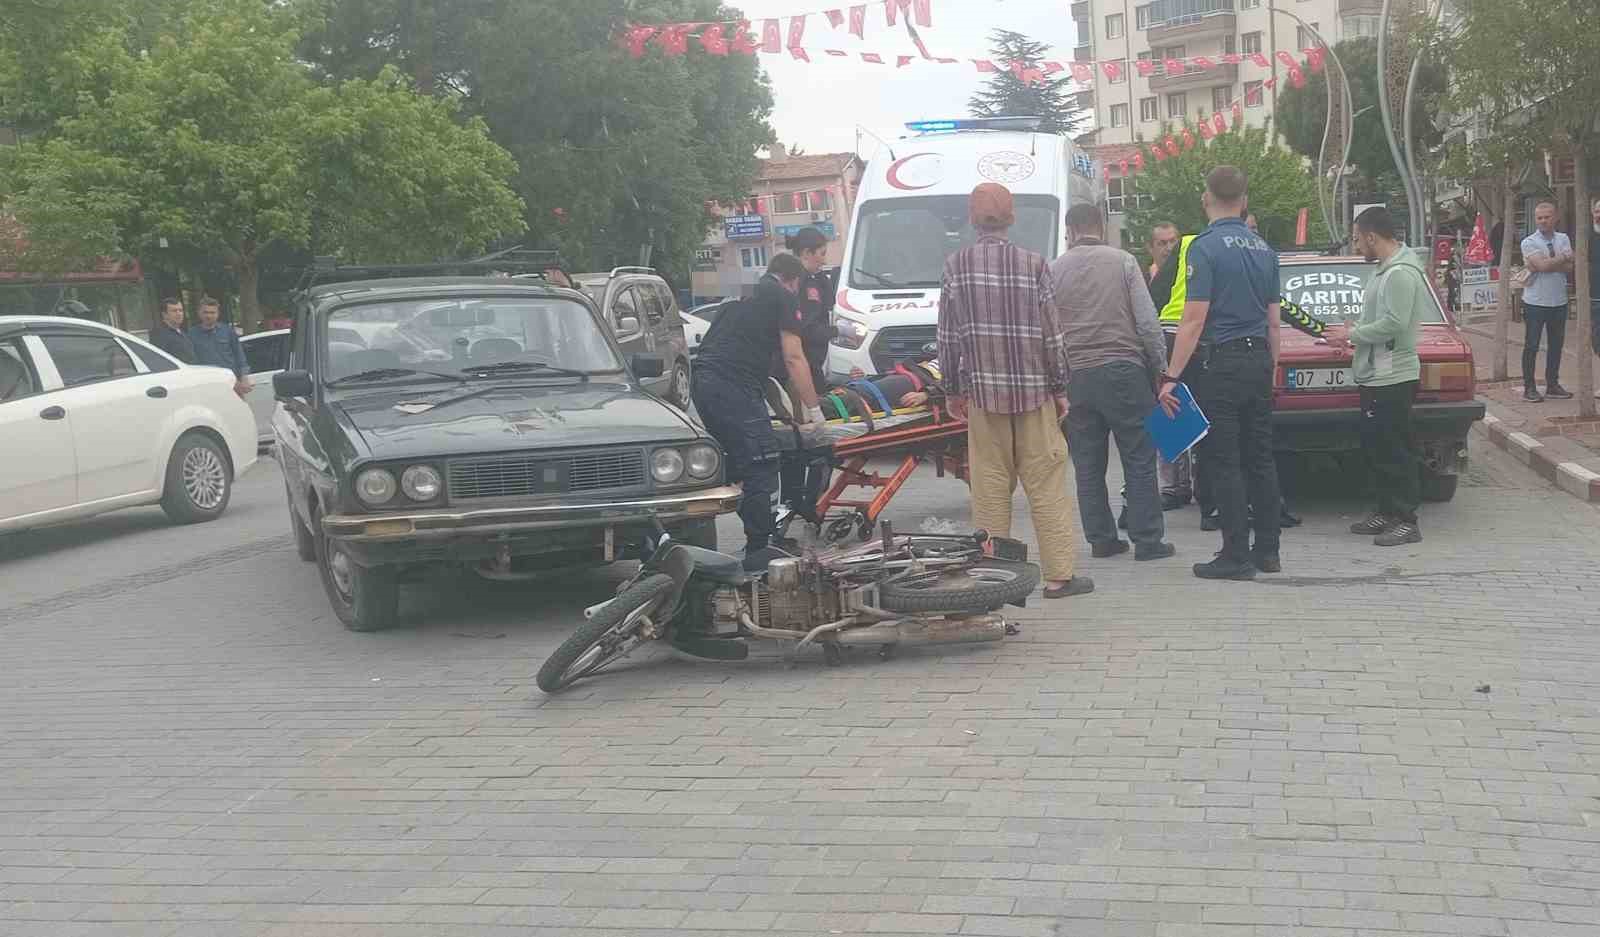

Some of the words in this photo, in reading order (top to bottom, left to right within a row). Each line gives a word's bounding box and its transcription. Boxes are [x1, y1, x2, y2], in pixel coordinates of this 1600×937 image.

[1300, 289, 1364, 305] ARITM
[1314, 305, 1339, 315] 652
[1343, 304, 1363, 315] 30
[1296, 371, 1314, 386] 07
